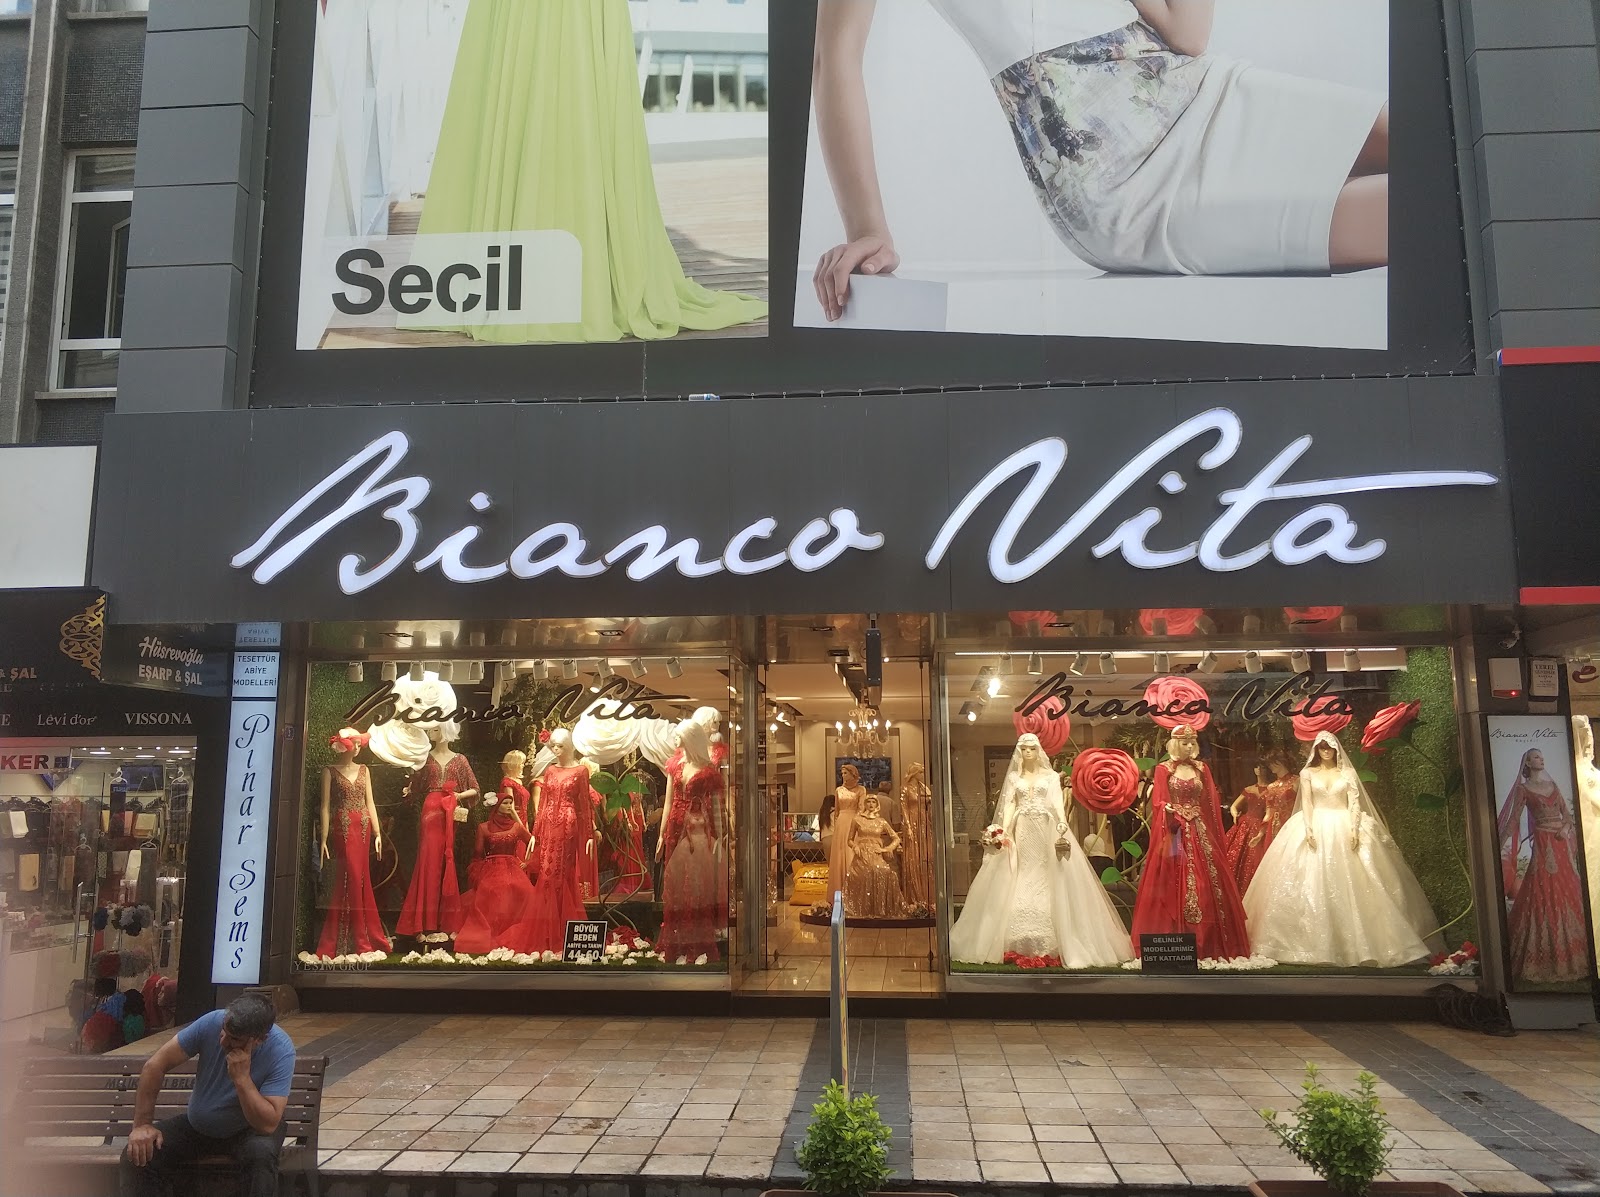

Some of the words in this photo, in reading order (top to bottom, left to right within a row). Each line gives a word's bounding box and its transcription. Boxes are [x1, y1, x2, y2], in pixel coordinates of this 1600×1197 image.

[230, 429, 885, 595] Bianco
[924, 406, 1499, 584] Vita
[138, 636, 205, 667] Hüsrevoğlu
[237, 653, 277, 663] TESETTÜR
[10, 667, 38, 682] ŞAL
[138, 664, 173, 682] EŞARP
[174, 669, 182, 683] &
[184, 671, 203, 687] ŞAL
[244, 665, 268, 675] ABİYE
[233, 677, 277, 687] MODELLERİ
[1014, 671, 1214, 721] Bianco
[1223, 670, 1390, 721] Vita
[342, 680, 527, 727] Bianco
[543, 677, 692, 724] Vita
[124, 712, 193, 726] VISSONA
[1531, 727, 1564, 739] Vita
[574, 924, 599, 933] BÜYÜK
[573, 934, 597, 942] BEDEN
[1143, 945, 1195, 953] MODELLERİMİZ
[1143, 954, 1158, 962] ÜST
